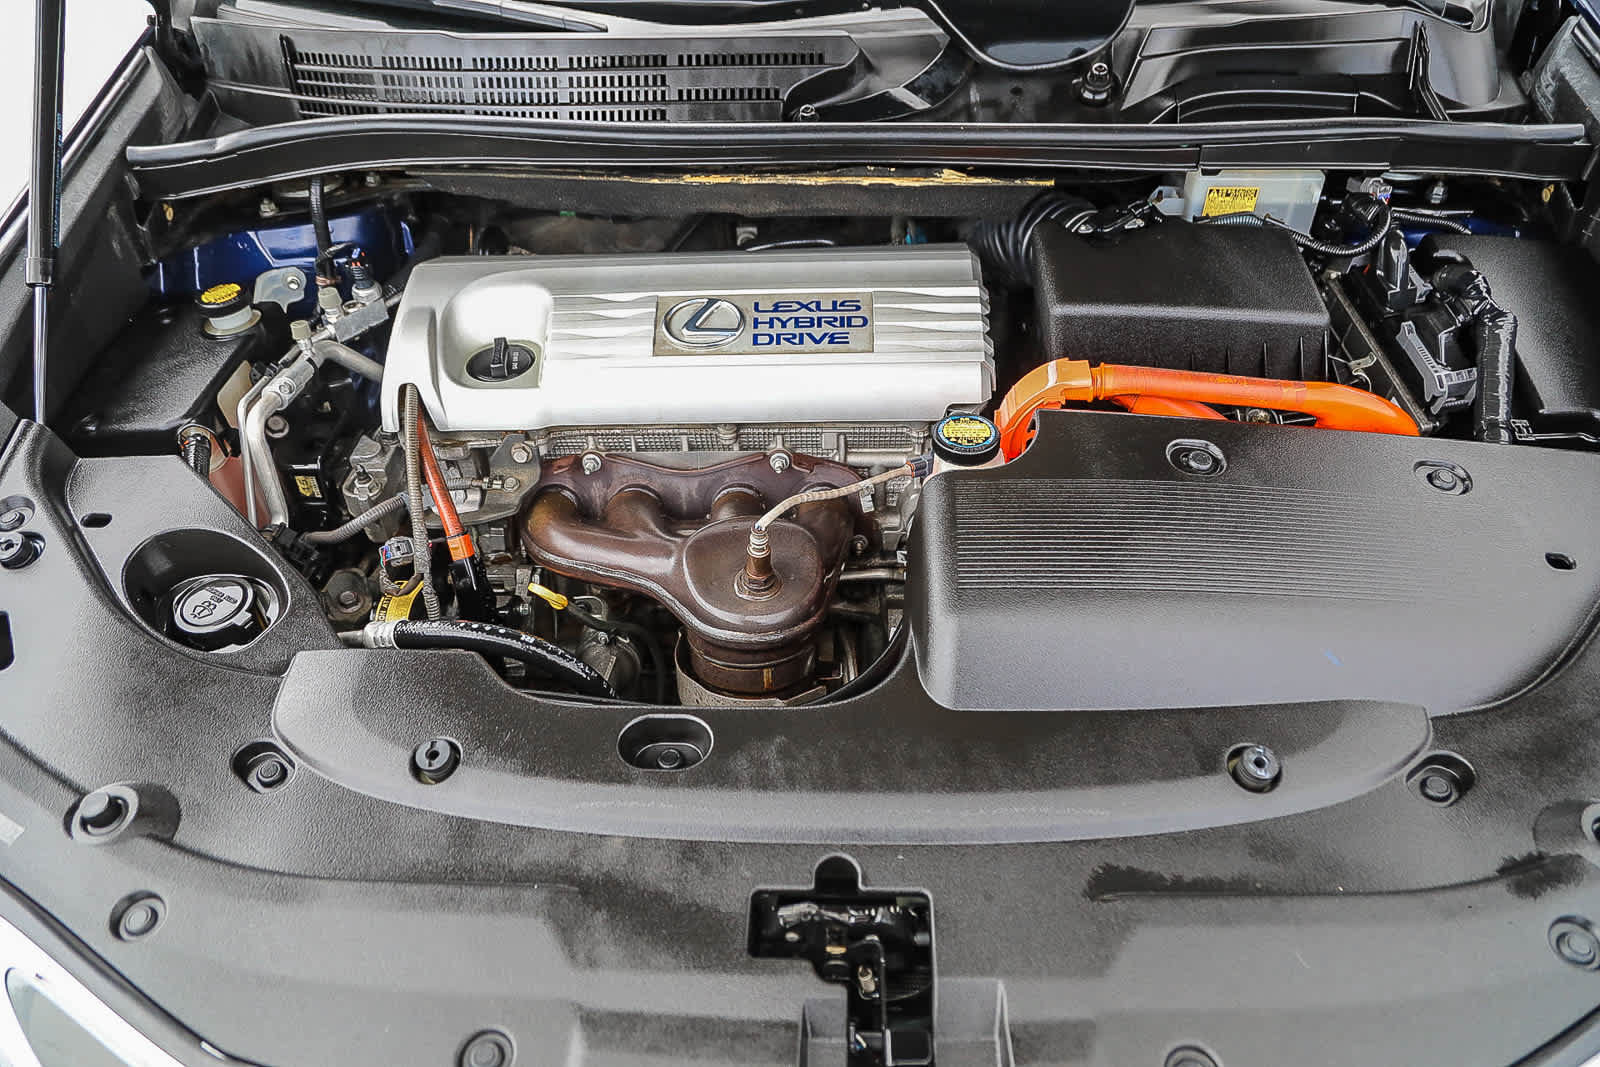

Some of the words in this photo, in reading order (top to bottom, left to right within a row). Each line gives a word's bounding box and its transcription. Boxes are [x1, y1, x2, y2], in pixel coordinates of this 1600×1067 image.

[753, 299, 862, 313] LEXUS
[752, 315, 869, 330] HYBRID
[752, 331, 850, 346] DRIVE
